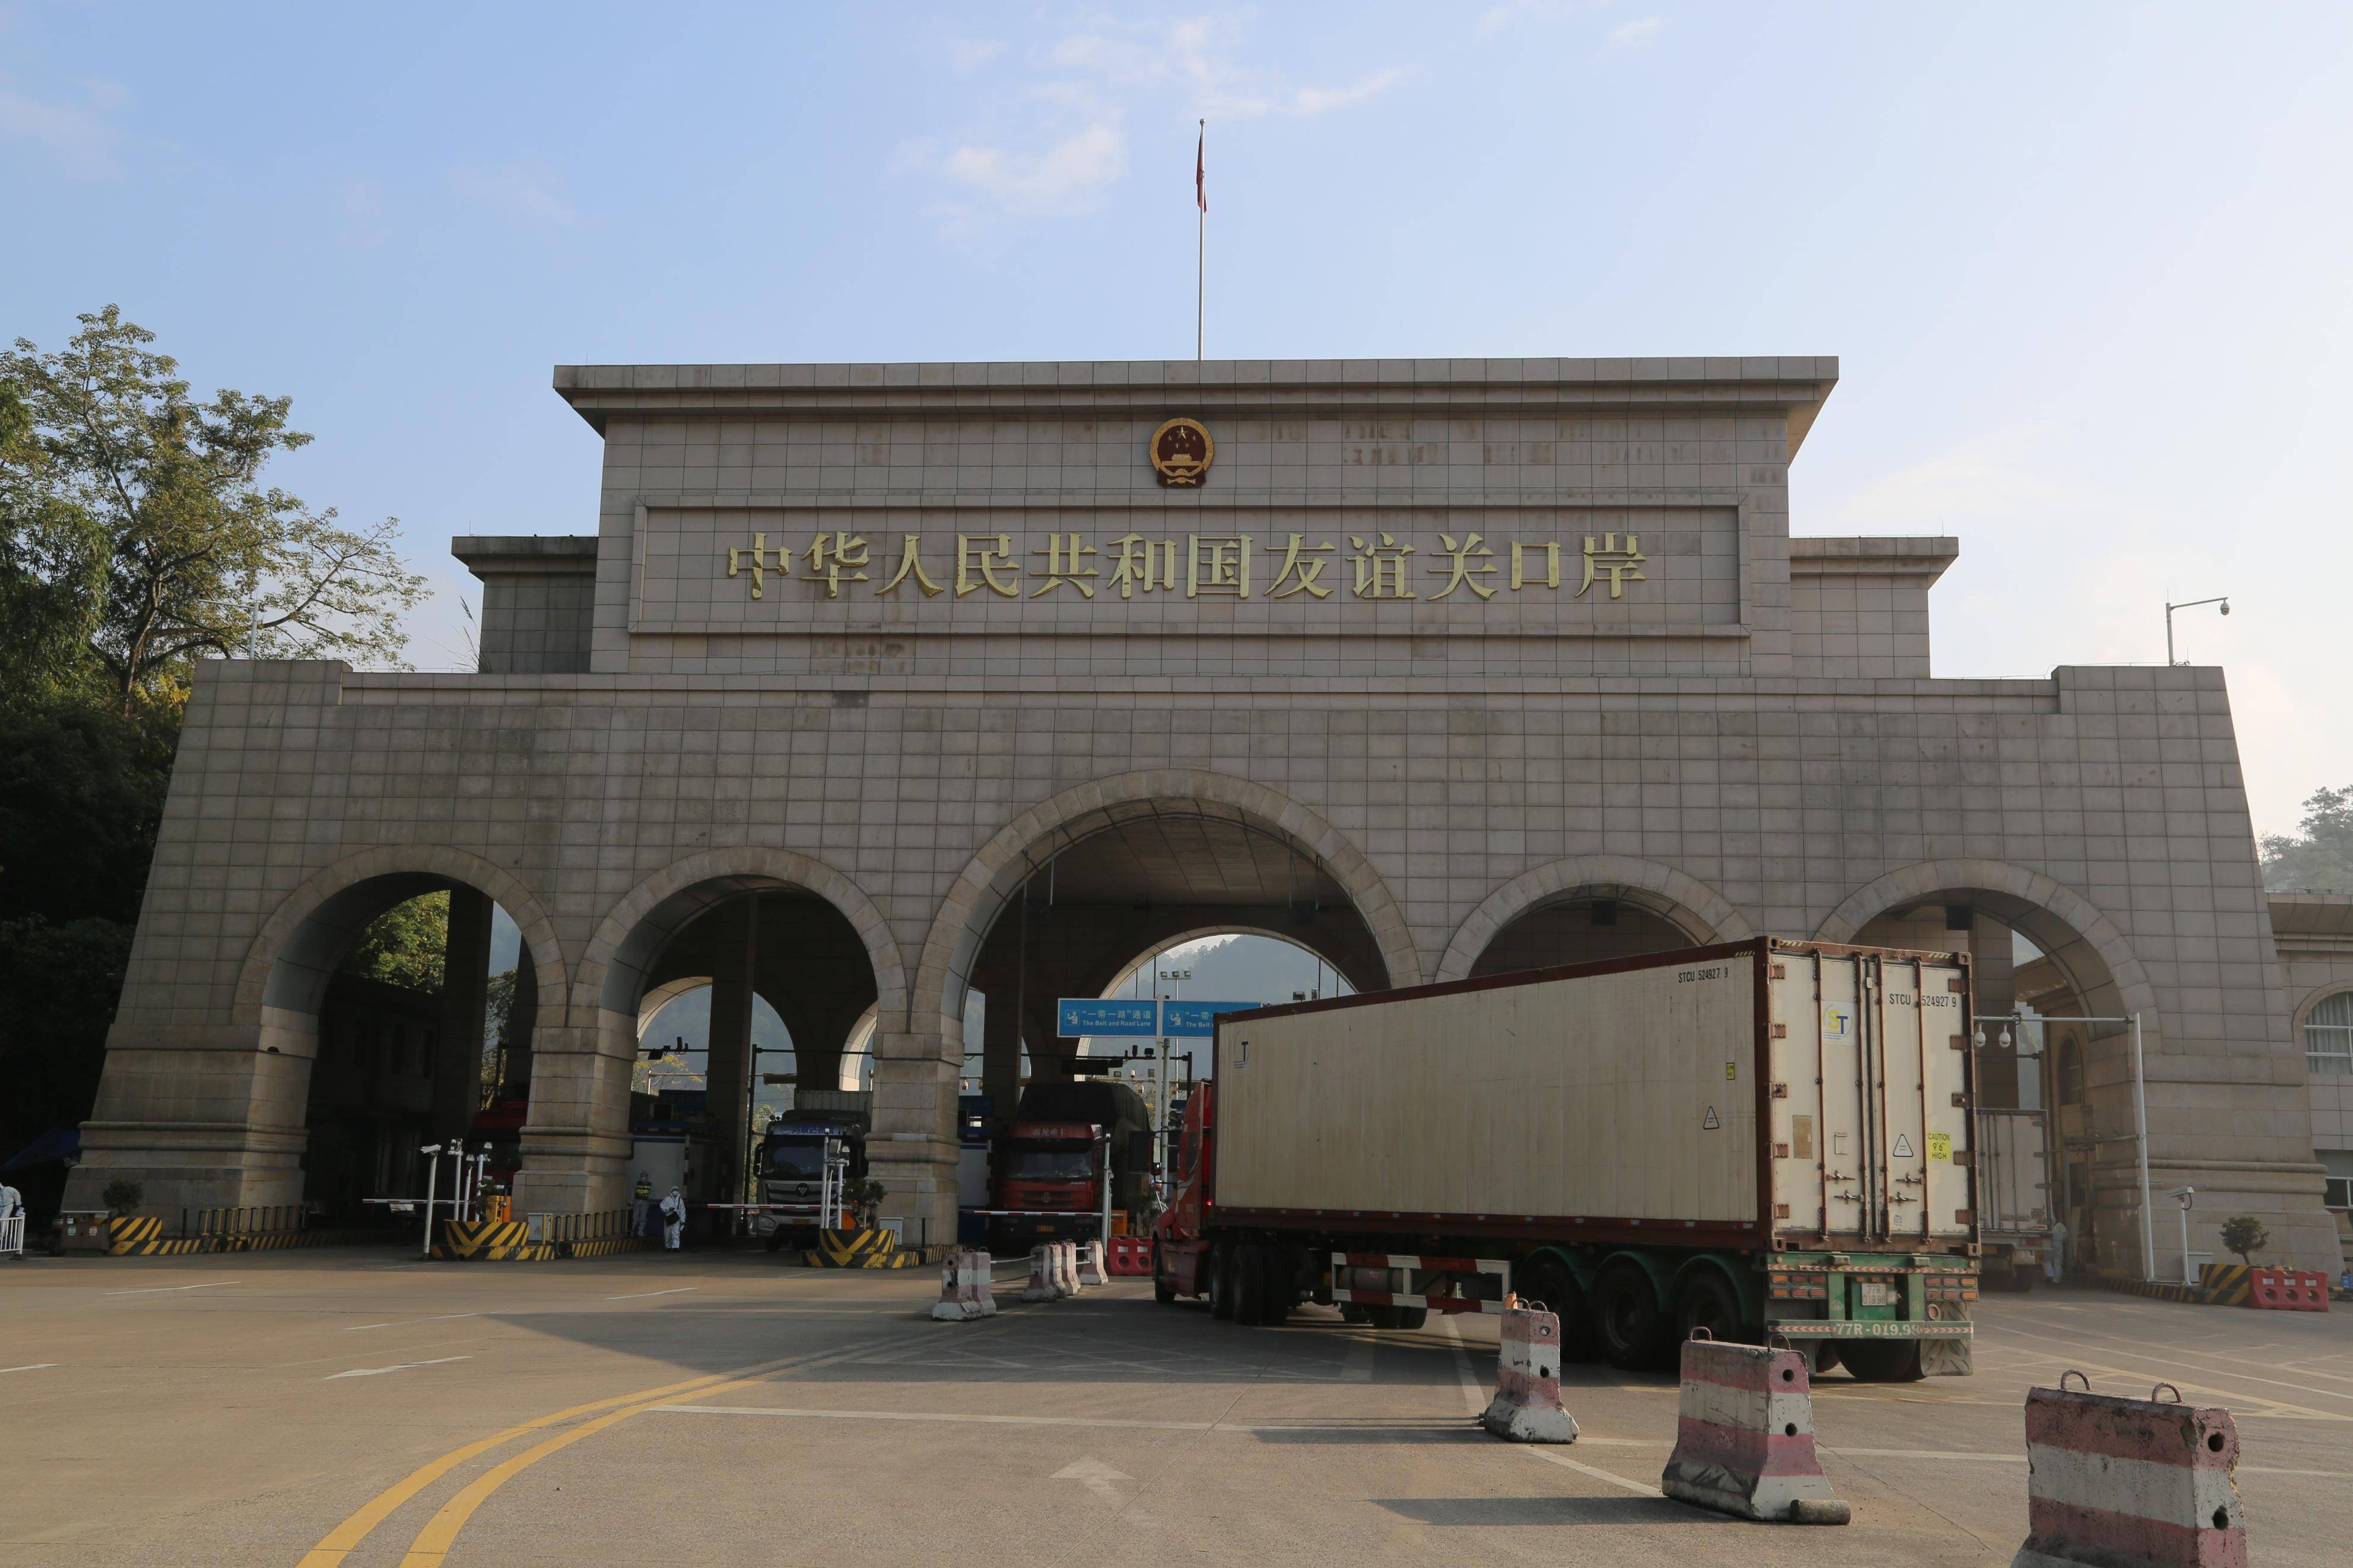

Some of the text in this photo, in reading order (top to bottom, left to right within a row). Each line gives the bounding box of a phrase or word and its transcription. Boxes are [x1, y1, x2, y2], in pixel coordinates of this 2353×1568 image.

[728, 532, 1647, 602] 中华人民共和国友谊关口岸
[1678, 967, 1728, 983] STCU 524927 9
[1890, 994, 1957, 1007] STCU 524927 9
[1929, 1133, 1950, 1141] CAUTION
